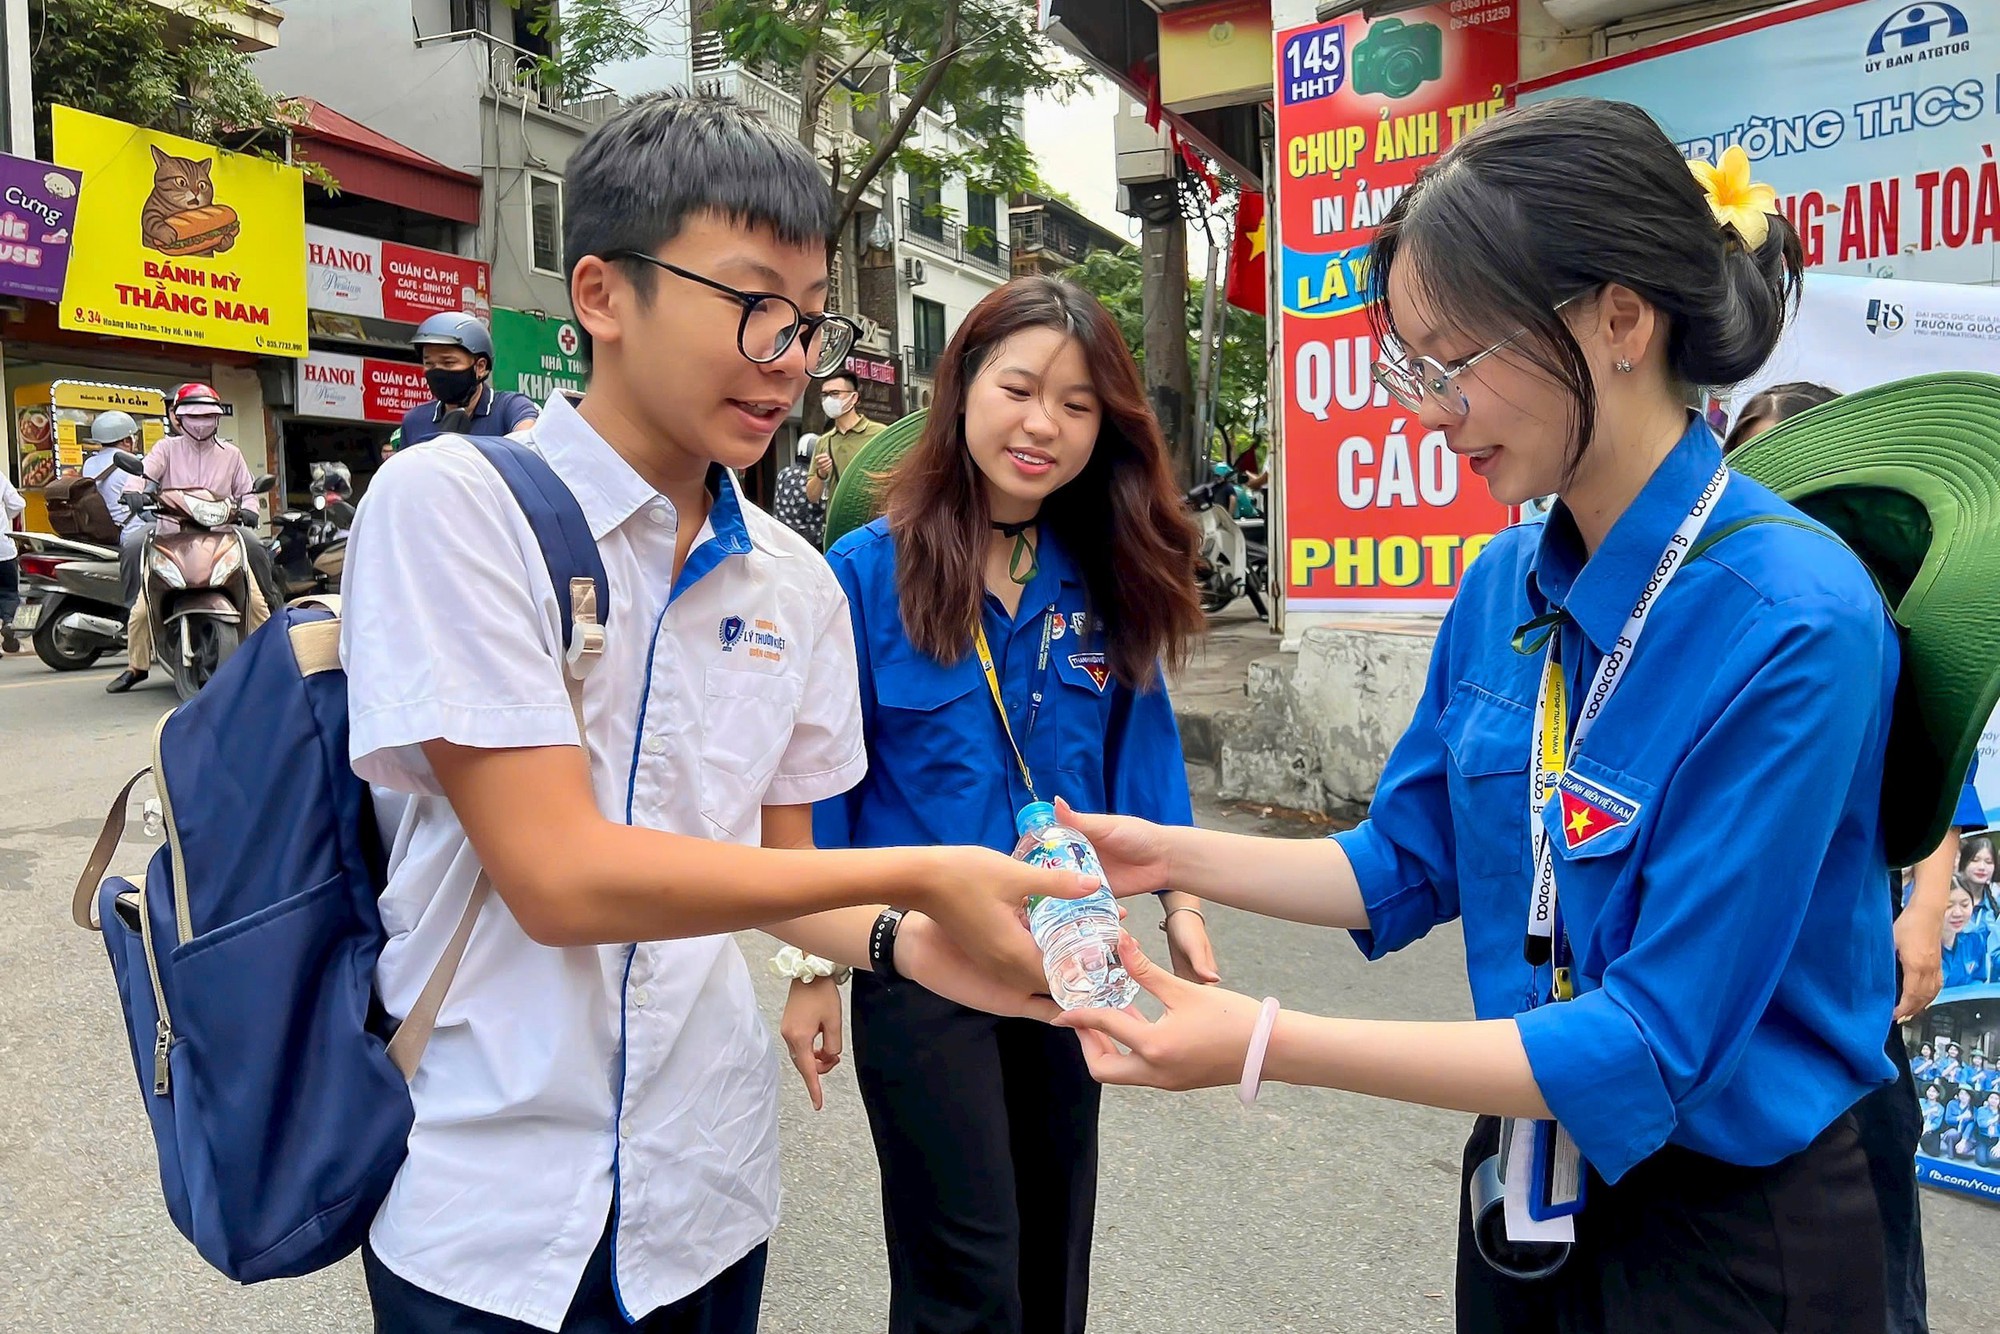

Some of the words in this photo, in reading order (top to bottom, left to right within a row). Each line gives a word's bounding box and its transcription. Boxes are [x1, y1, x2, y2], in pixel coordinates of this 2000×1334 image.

[1287, 33, 1341, 79] 145
[1886, 53, 1913, 68] BAN
[1918, 41, 1970, 62] ATGTQG
[1291, 75, 1339, 101] HHT
[1855, 79, 1984, 140] THCS
[1288, 126, 1366, 180] CHỤP
[1374, 107, 1439, 165] ẢNH
[5, 187, 63, 226] Cưng
[1312, 196, 1343, 236] IN
[1351, 179, 1412, 230] ẢN
[1838, 178, 1900, 263] AN
[308, 243, 373, 276] HANOI
[389, 261, 421, 278] QUÁN
[424, 267, 438, 281] CÀ
[440, 270, 459, 285] PHÊ
[144, 260, 205, 287] BÁNH
[211, 273, 241, 292] MỲ
[398, 278, 417, 290] CAFE
[422, 282, 440, 293] SINH
[442, 285, 452, 295] TỐ
[115, 282, 207, 316] THẰNG
[215, 301, 269, 326] NAM
[395, 289, 419, 302] NƯỚC
[419, 293, 435, 303] GIẢI
[436, 296, 456, 308] KHÁT
[88, 310, 101, 324] 34
[304, 364, 355, 386] HANOI
[372, 371, 402, 386] QUÁN
[405, 374, 419, 388] CÀ
[108, 393, 126, 405] SÀI
[128, 396, 149, 407] GÒN
[377, 397, 400, 408] NƯỚC
[380, 386, 399, 397] CAFE
[404, 388, 421, 399] SINH
[1338, 418, 1459, 510] CÁO
[743, 630, 754, 643] LÝ
[1561, 776, 1584, 795] THANH
[1611, 804, 1633, 820] NAM
